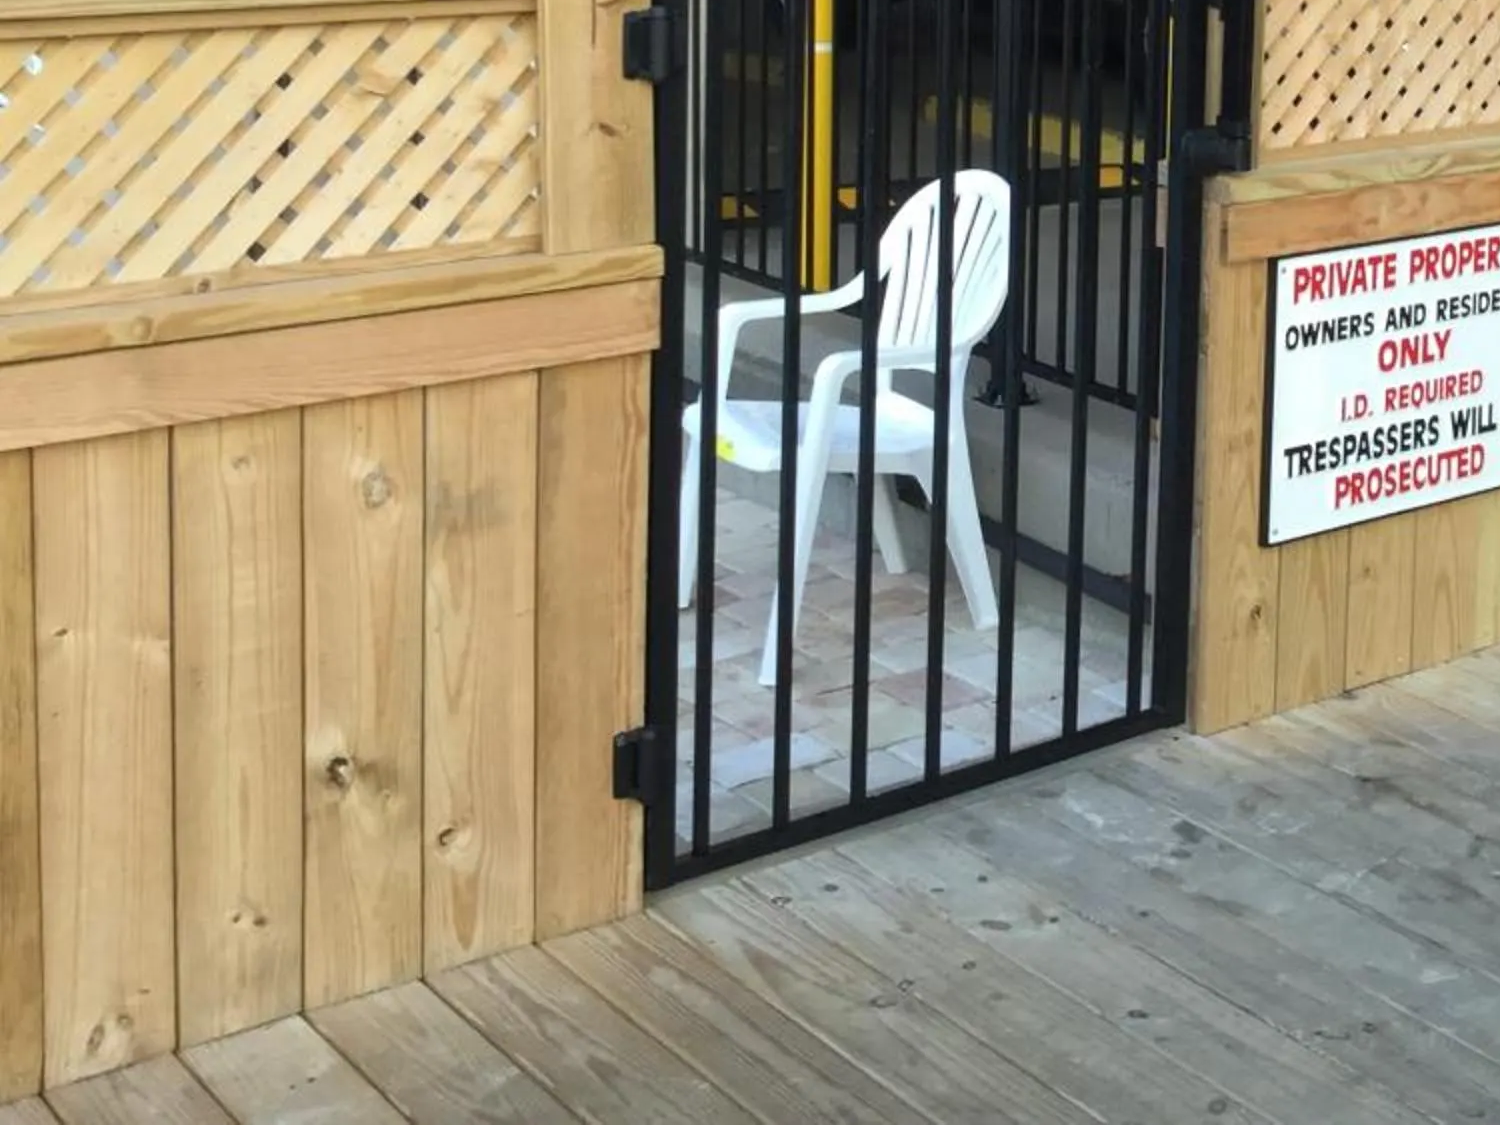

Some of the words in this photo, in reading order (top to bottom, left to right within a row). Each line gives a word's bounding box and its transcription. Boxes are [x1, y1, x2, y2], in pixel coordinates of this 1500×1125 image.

[1294, 253, 1397, 304] PRIVATE
[1285, 312, 1375, 351] OWNERS
[1385, 303, 1427, 332] AND
[1378, 329, 1452, 373] ONLY
[1341, 394, 1373, 422] I.D.
[1385, 370, 1484, 411] REQUIRED
[1284, 415, 1440, 478] TRESPASSERS
[1451, 404, 1497, 440] WILL
[1334, 444, 1485, 509] PROSECUTED
